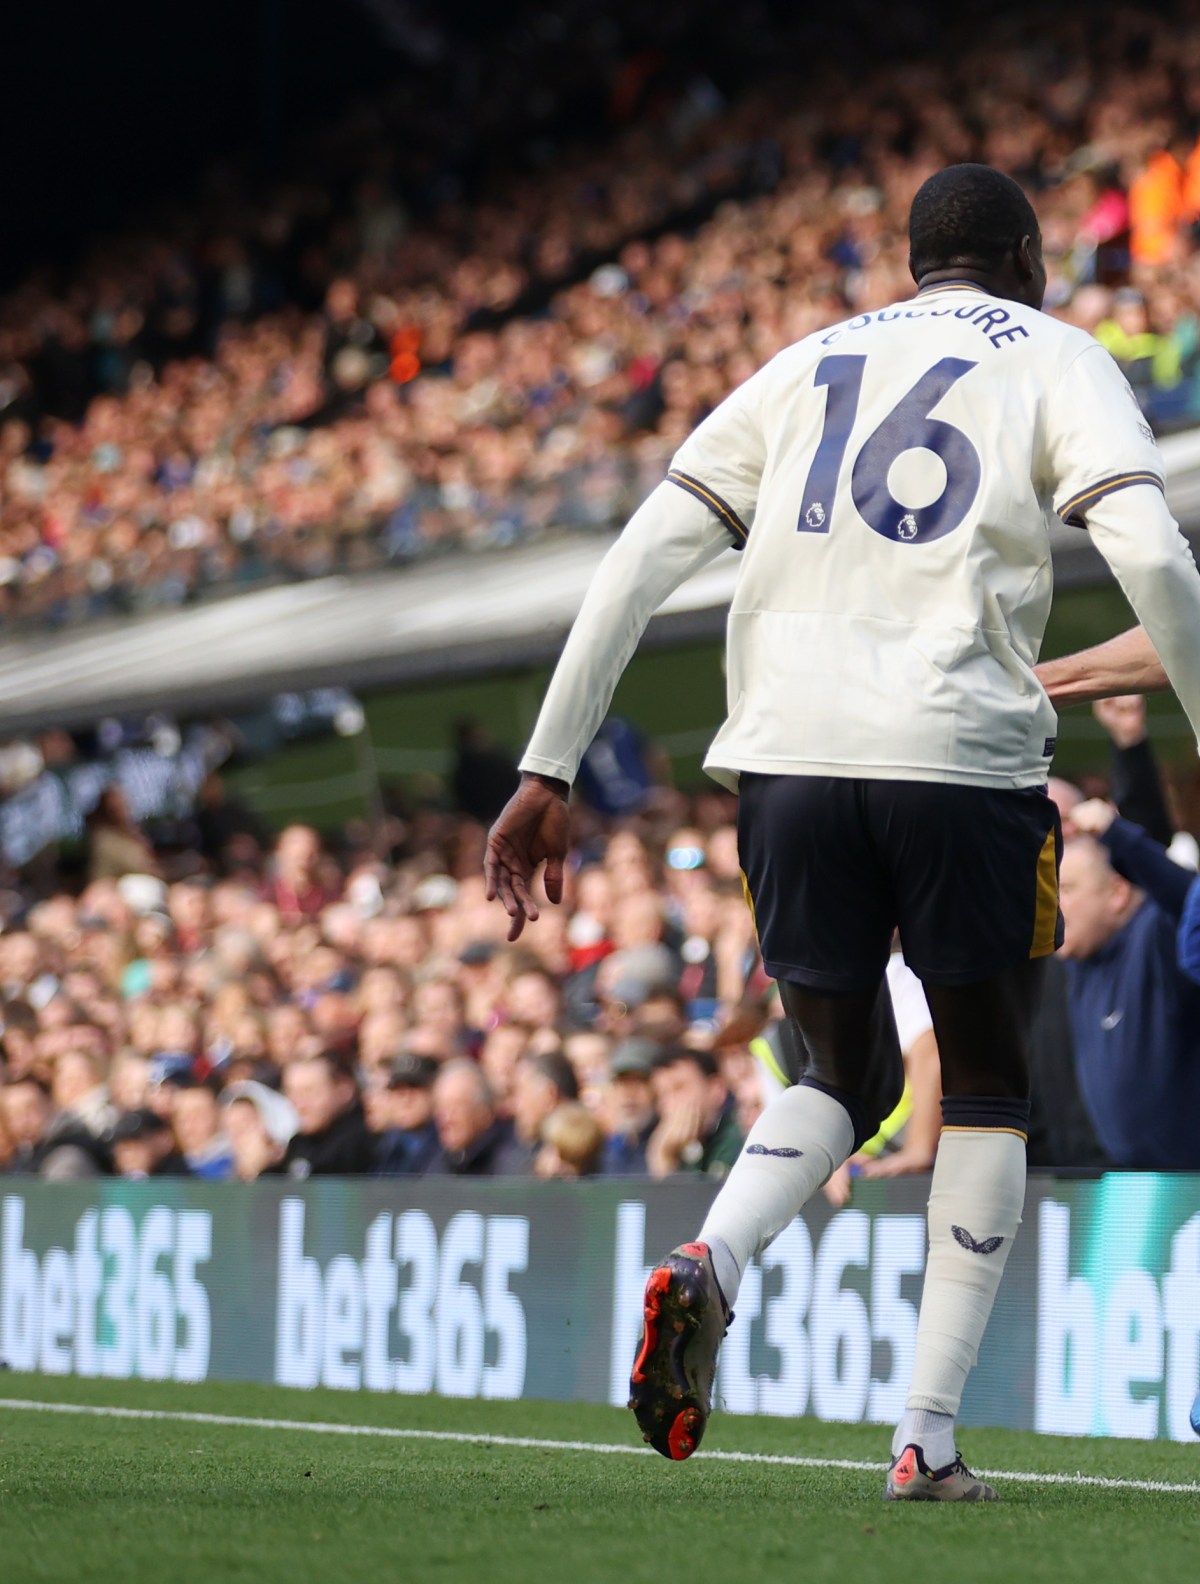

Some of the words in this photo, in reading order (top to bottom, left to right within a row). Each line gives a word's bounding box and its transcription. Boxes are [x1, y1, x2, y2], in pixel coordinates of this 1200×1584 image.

[797, 354, 981, 544] 16
[0, 1193, 213, 1384] bet365
[274, 1197, 530, 1399] bet365
